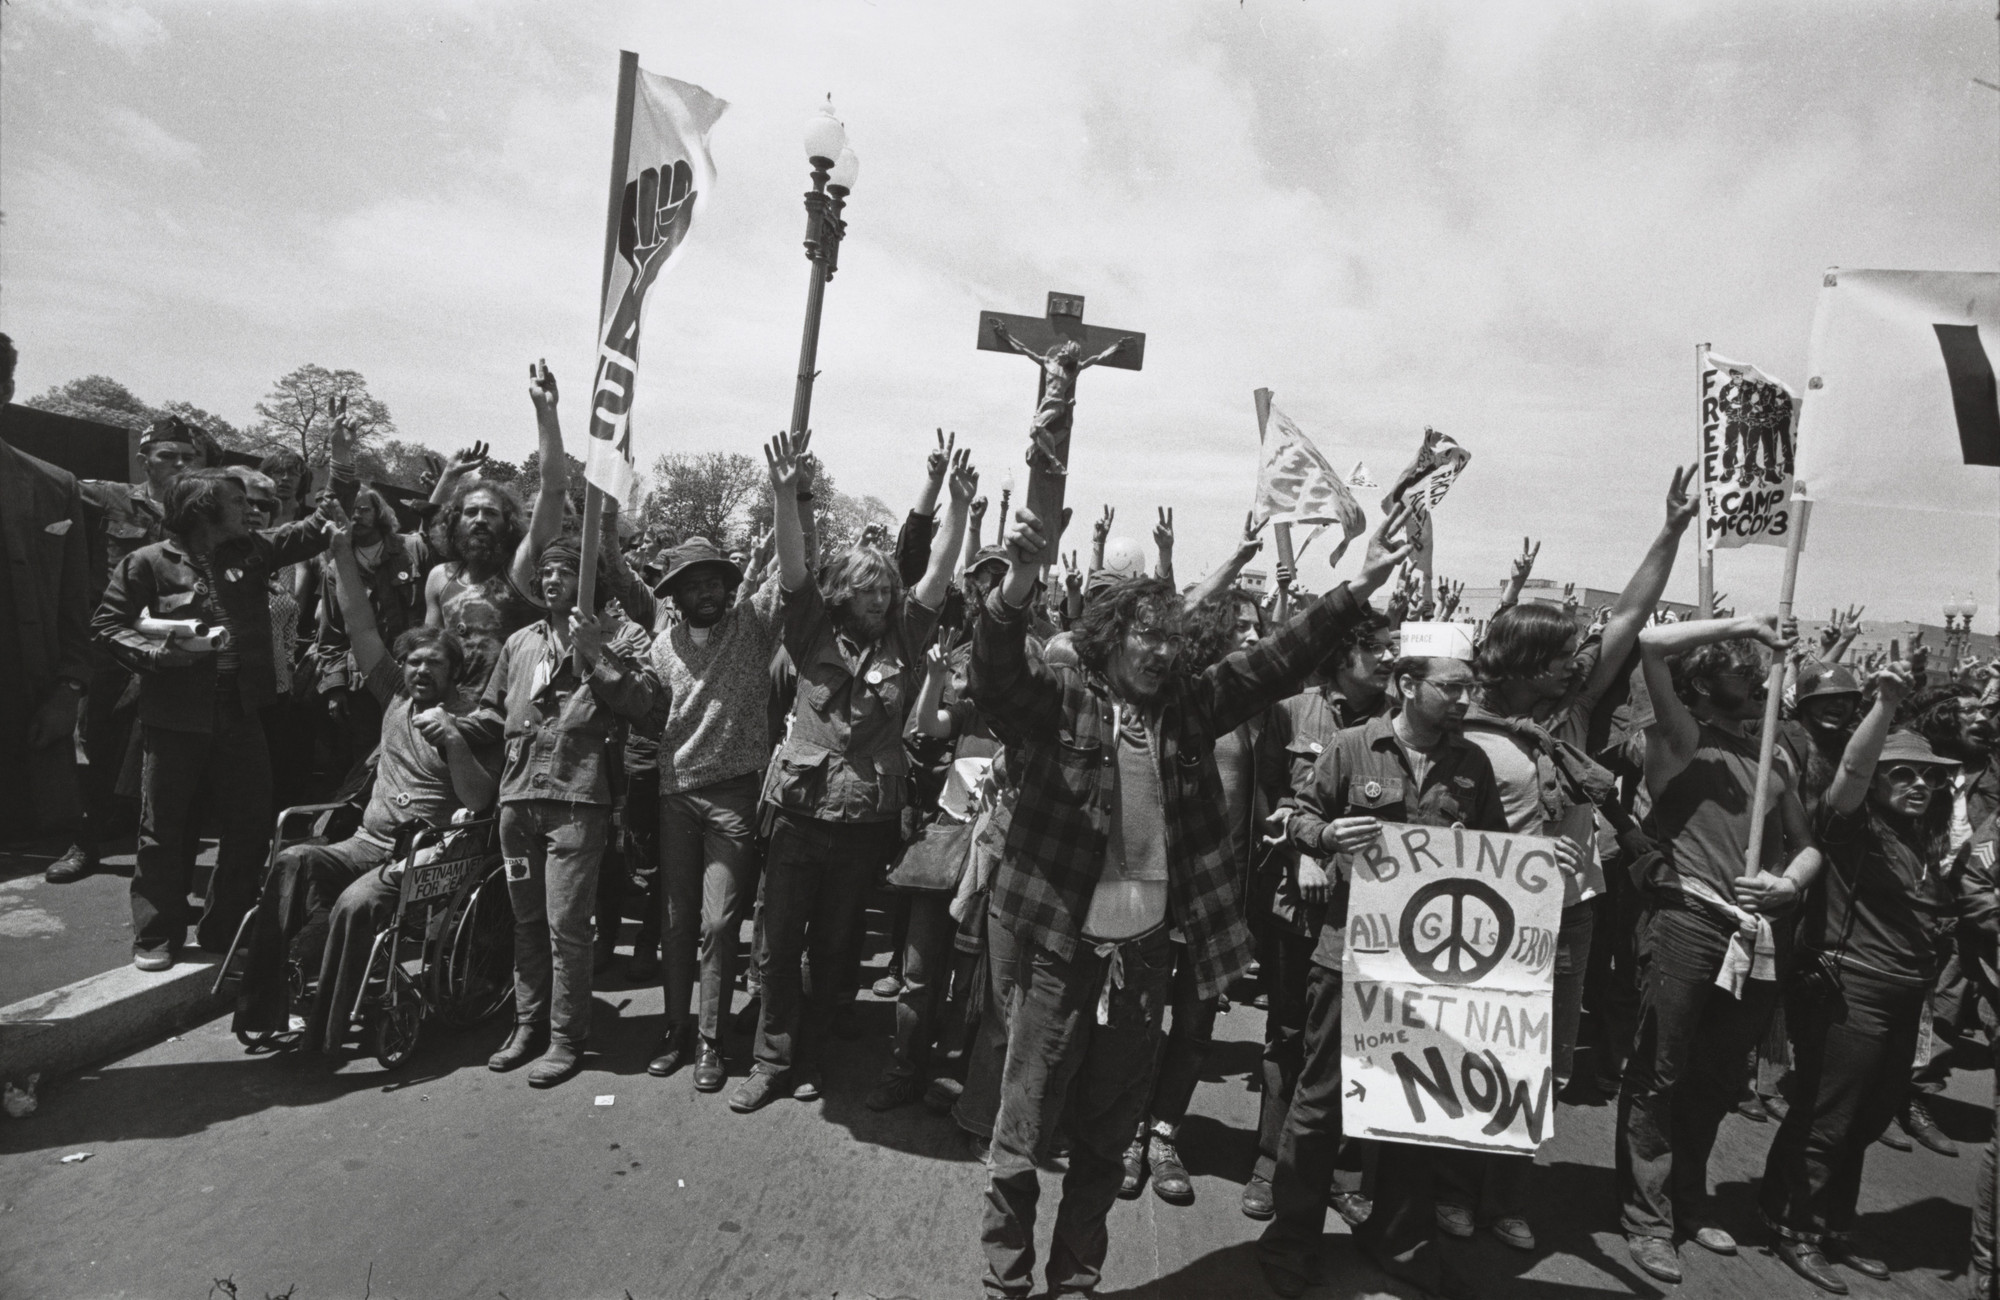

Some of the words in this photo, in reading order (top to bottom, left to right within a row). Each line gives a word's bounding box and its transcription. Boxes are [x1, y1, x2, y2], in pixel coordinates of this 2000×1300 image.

[1702, 369, 1720, 483] FREE
[1705, 487, 1719, 516] THE
[1720, 489, 1785, 516] CAMP
[1411, 633, 1432, 644] PEACE
[414, 862, 464, 885] VIETNAM
[1363, 828, 1555, 894] BRING
[415, 881, 440, 899] FOR
[1351, 912, 1400, 949] ALL
[1354, 1030, 1410, 1052] HOME
[1391, 1046, 1553, 1144] NOW
